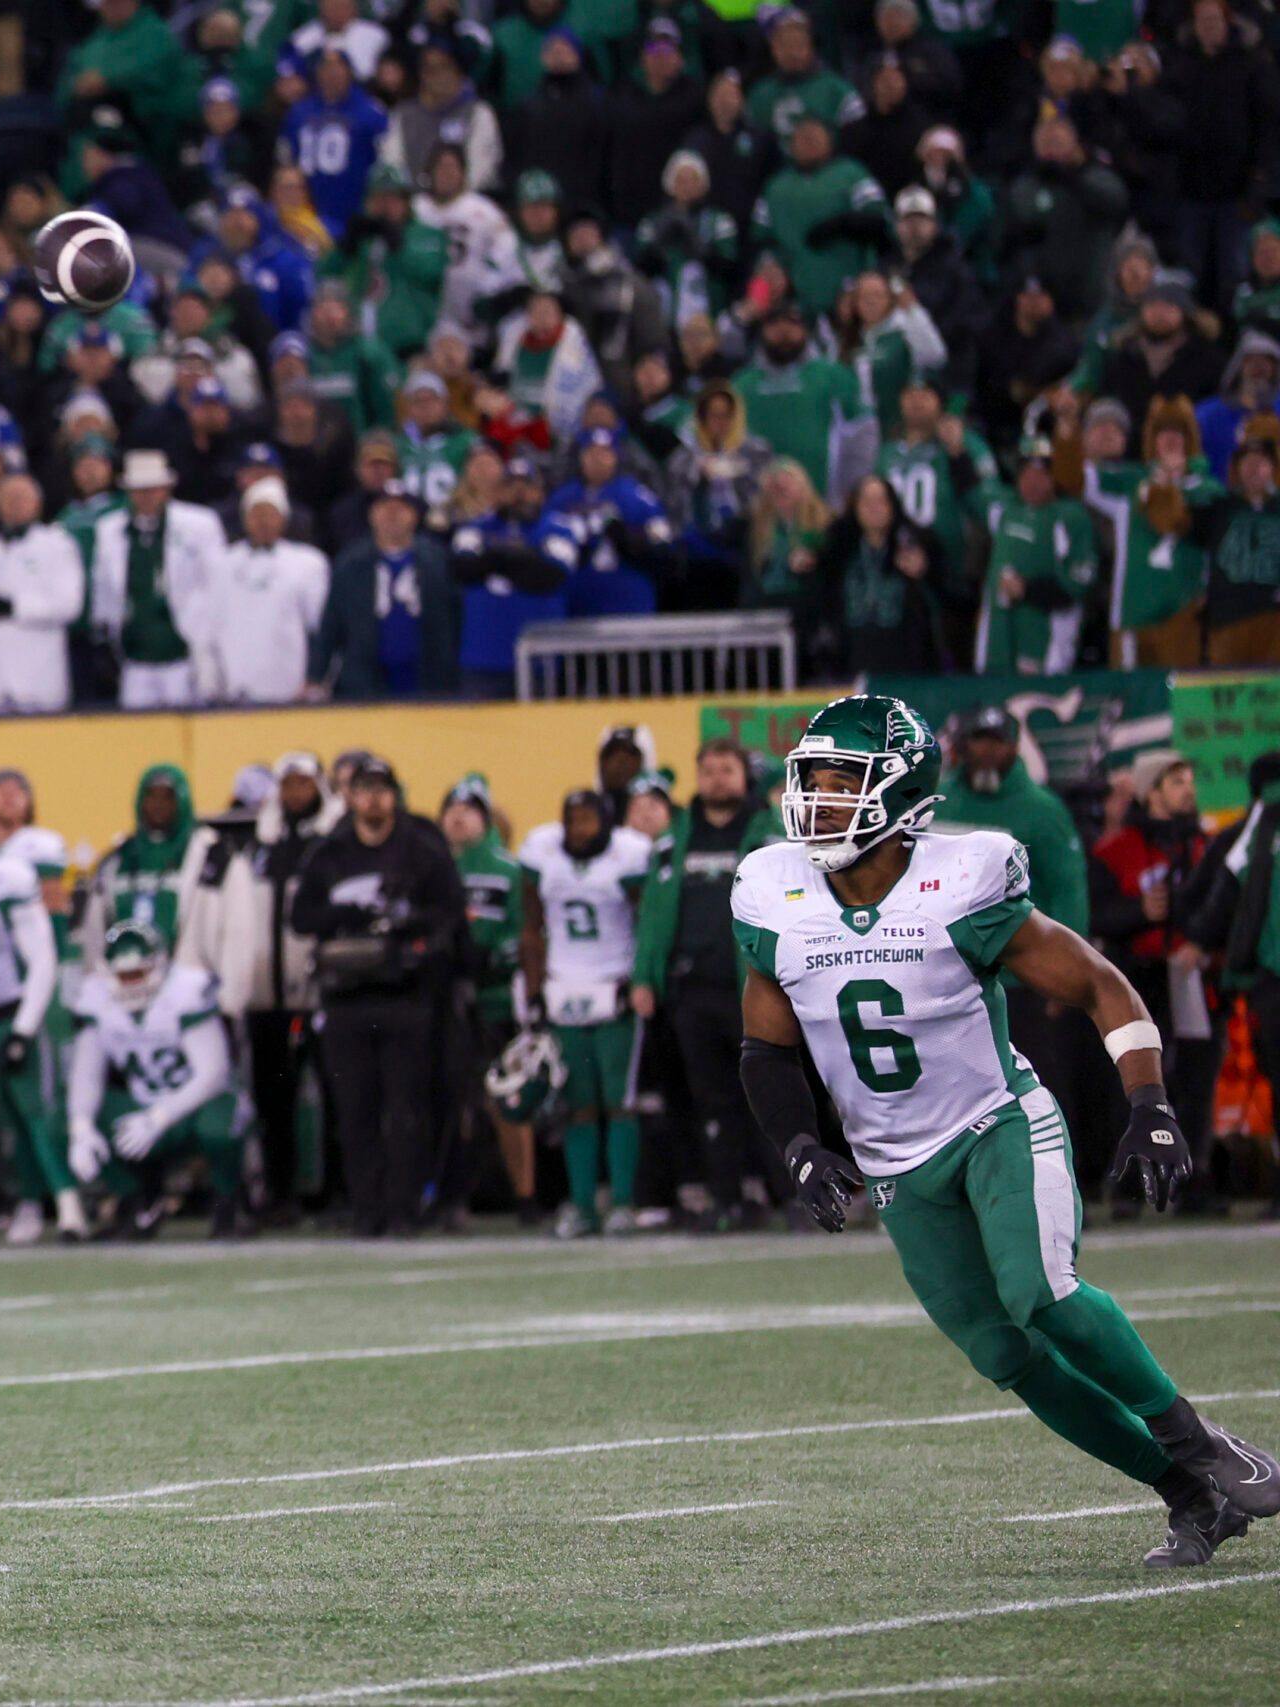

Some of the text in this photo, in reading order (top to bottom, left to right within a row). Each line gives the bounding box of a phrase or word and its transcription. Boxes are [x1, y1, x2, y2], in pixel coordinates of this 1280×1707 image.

[805, 927, 925, 945] WESTJET TELUS
[806, 948, 924, 970] SASKATCHEWAN
[837, 979, 923, 1093] 6
